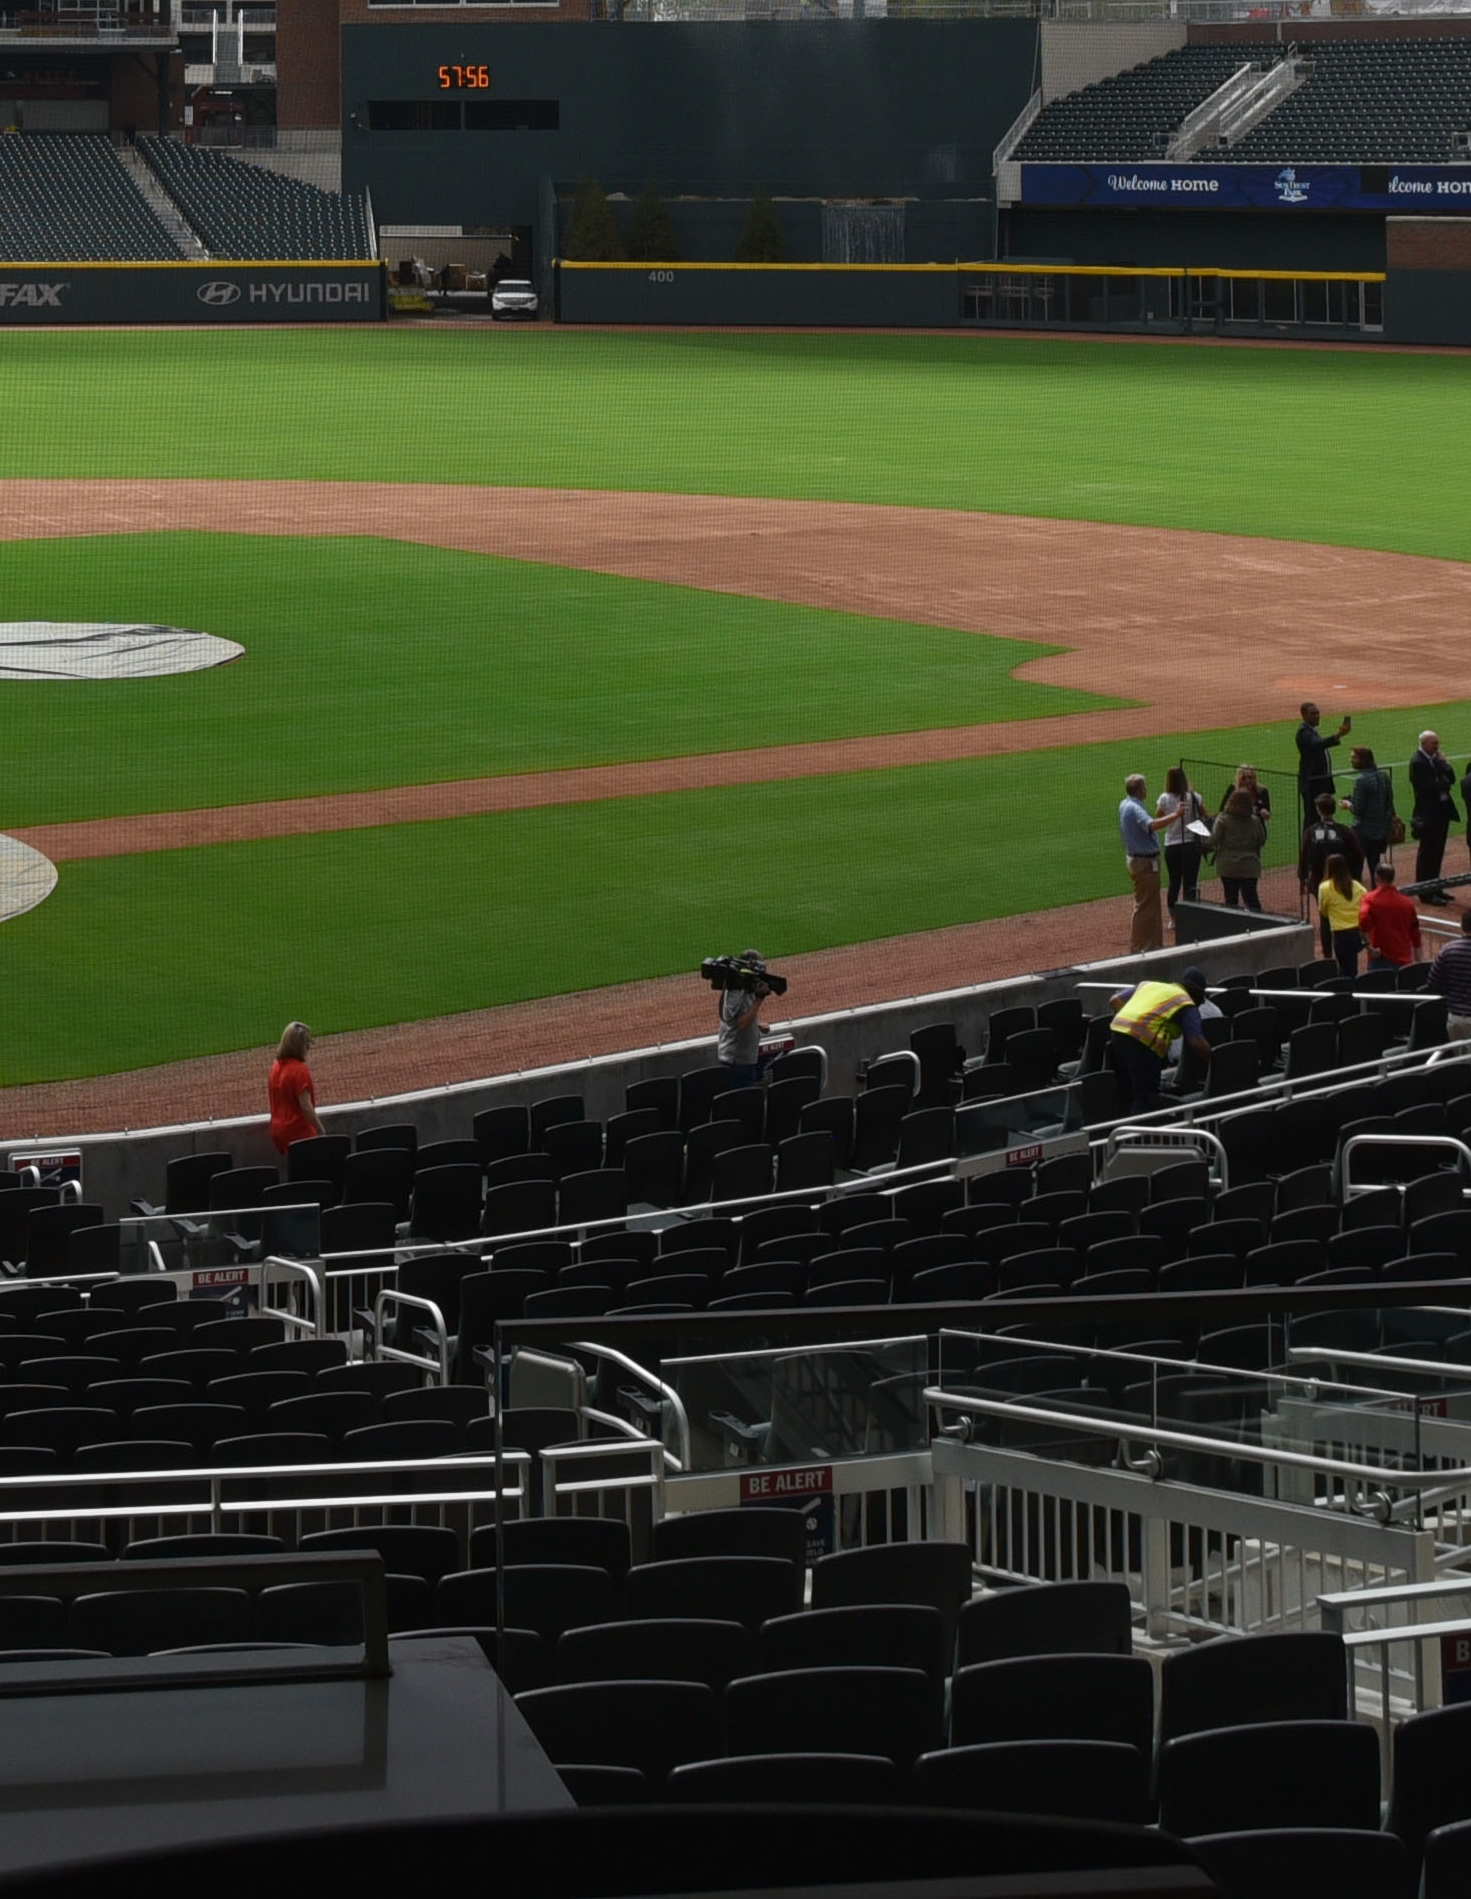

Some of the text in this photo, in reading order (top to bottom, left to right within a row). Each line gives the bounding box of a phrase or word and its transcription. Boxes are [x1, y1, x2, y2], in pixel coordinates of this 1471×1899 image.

[437, 64, 490, 89] 57:56
[1107, 173, 1168, 191] Welcome
[1388, 176, 1433, 194] elcome
[648, 270, 675, 283] 400
[249, 283, 370, 303] HYUNDAI
[749, 1470, 826, 1494] BE ALERT
